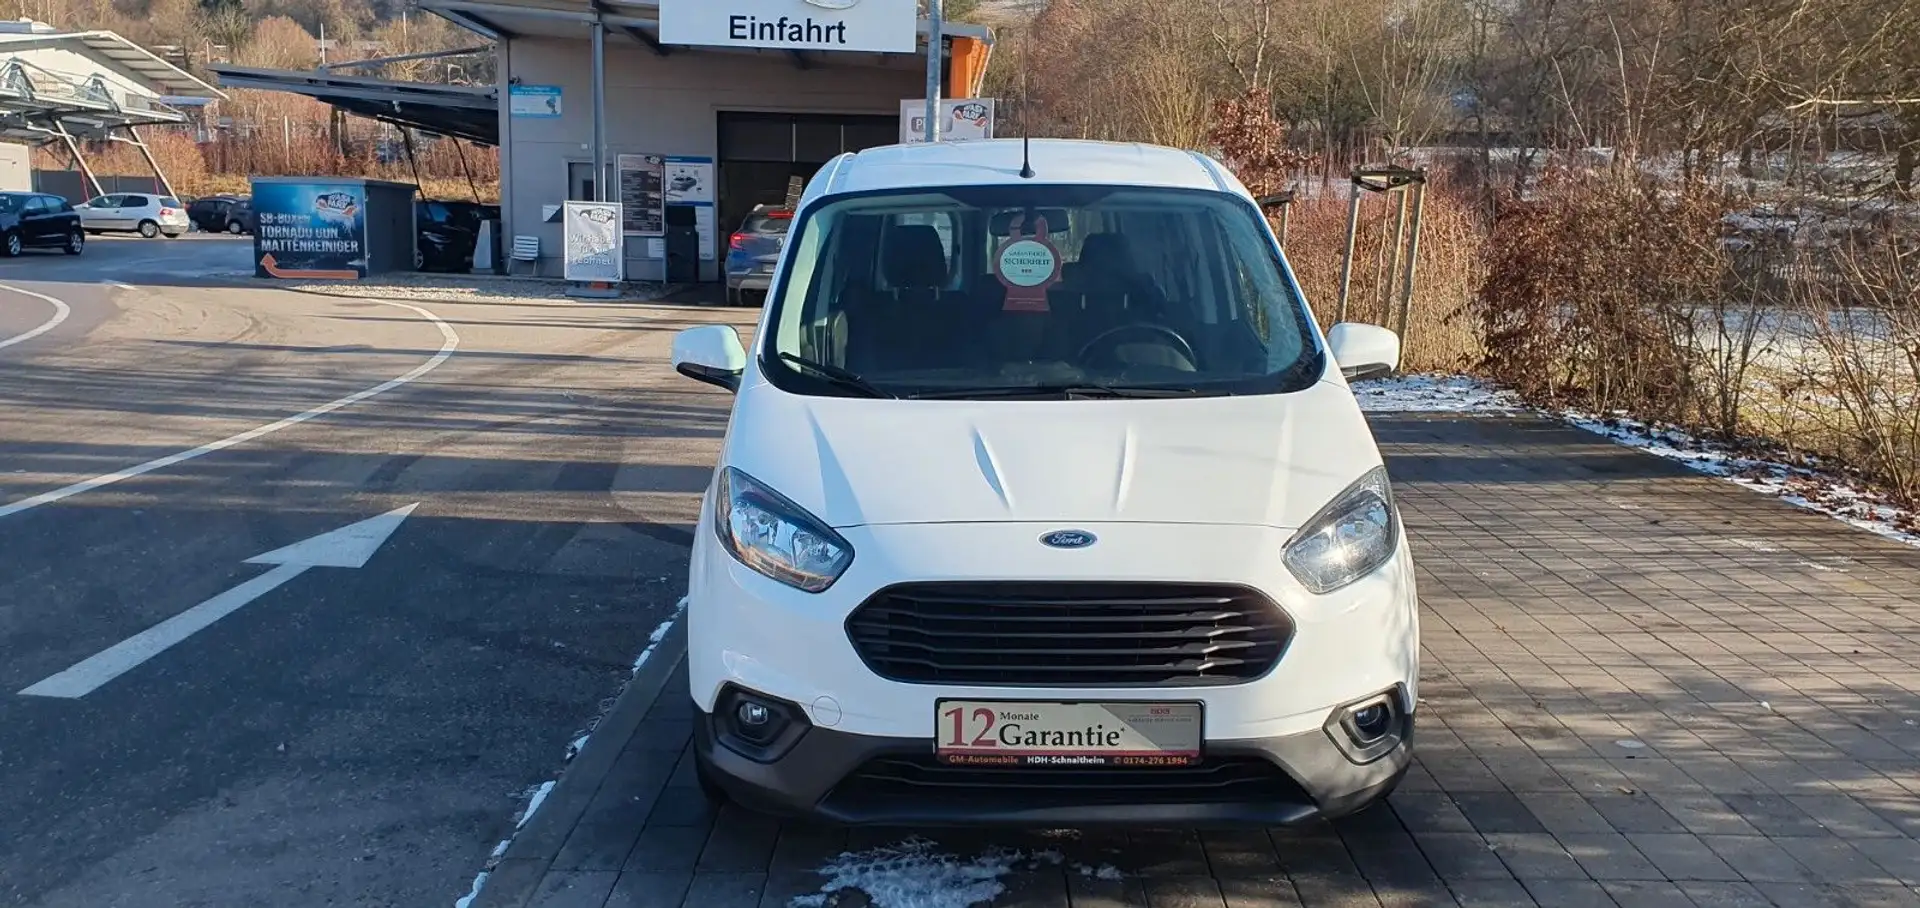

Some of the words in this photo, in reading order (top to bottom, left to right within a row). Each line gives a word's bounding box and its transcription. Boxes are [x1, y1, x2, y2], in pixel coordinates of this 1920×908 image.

[729, 15, 846, 44] Einfahrt
[260, 226, 313, 239] TORNADO
[260, 240, 359, 252] MATTENREINIGER
[1051, 532, 1084, 545] Ford
[1000, 711, 1039, 721] Monate
[944, 707, 997, 748] 12
[1027, 756, 1105, 764] HDH-Schnaitheim
